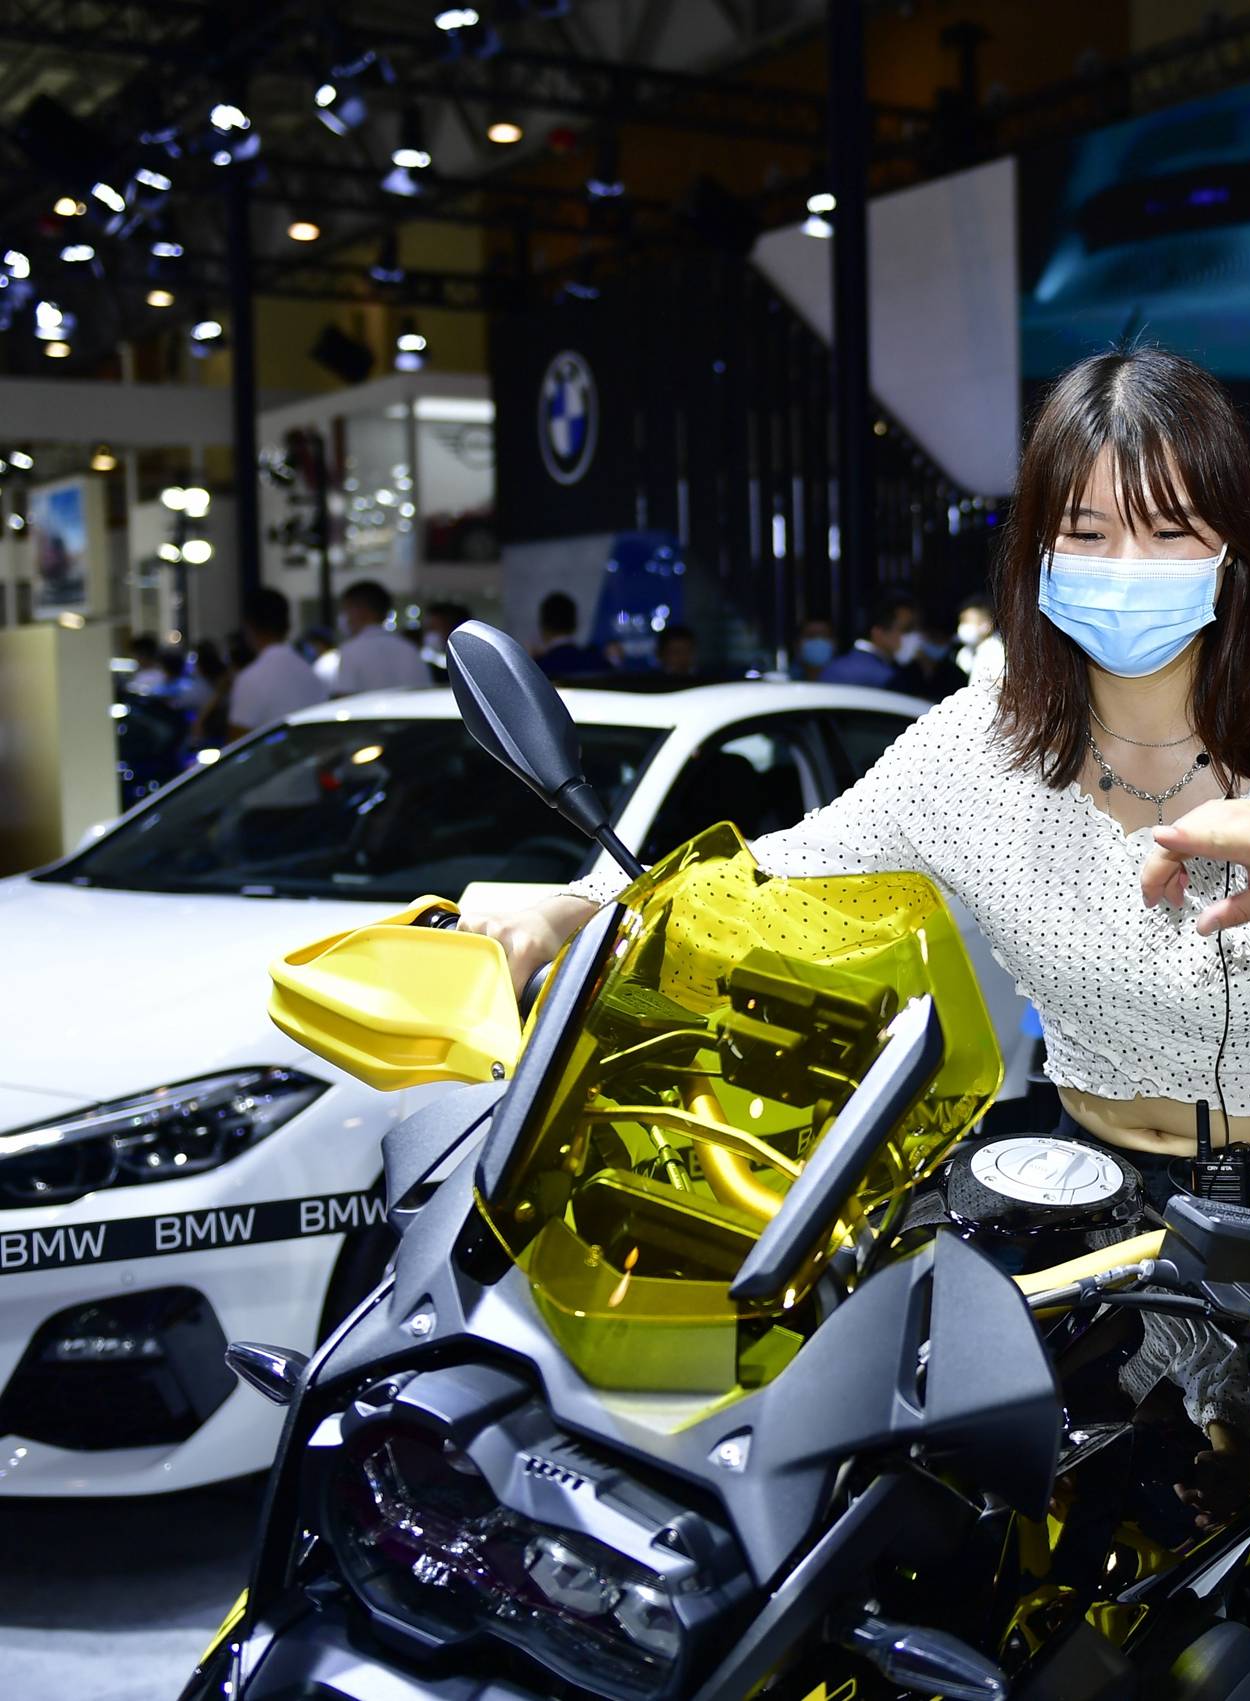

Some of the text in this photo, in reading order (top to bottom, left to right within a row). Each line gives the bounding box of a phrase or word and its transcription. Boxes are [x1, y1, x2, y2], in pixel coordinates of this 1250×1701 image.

[0, 1195, 388, 1268] BMW BMW BMW
